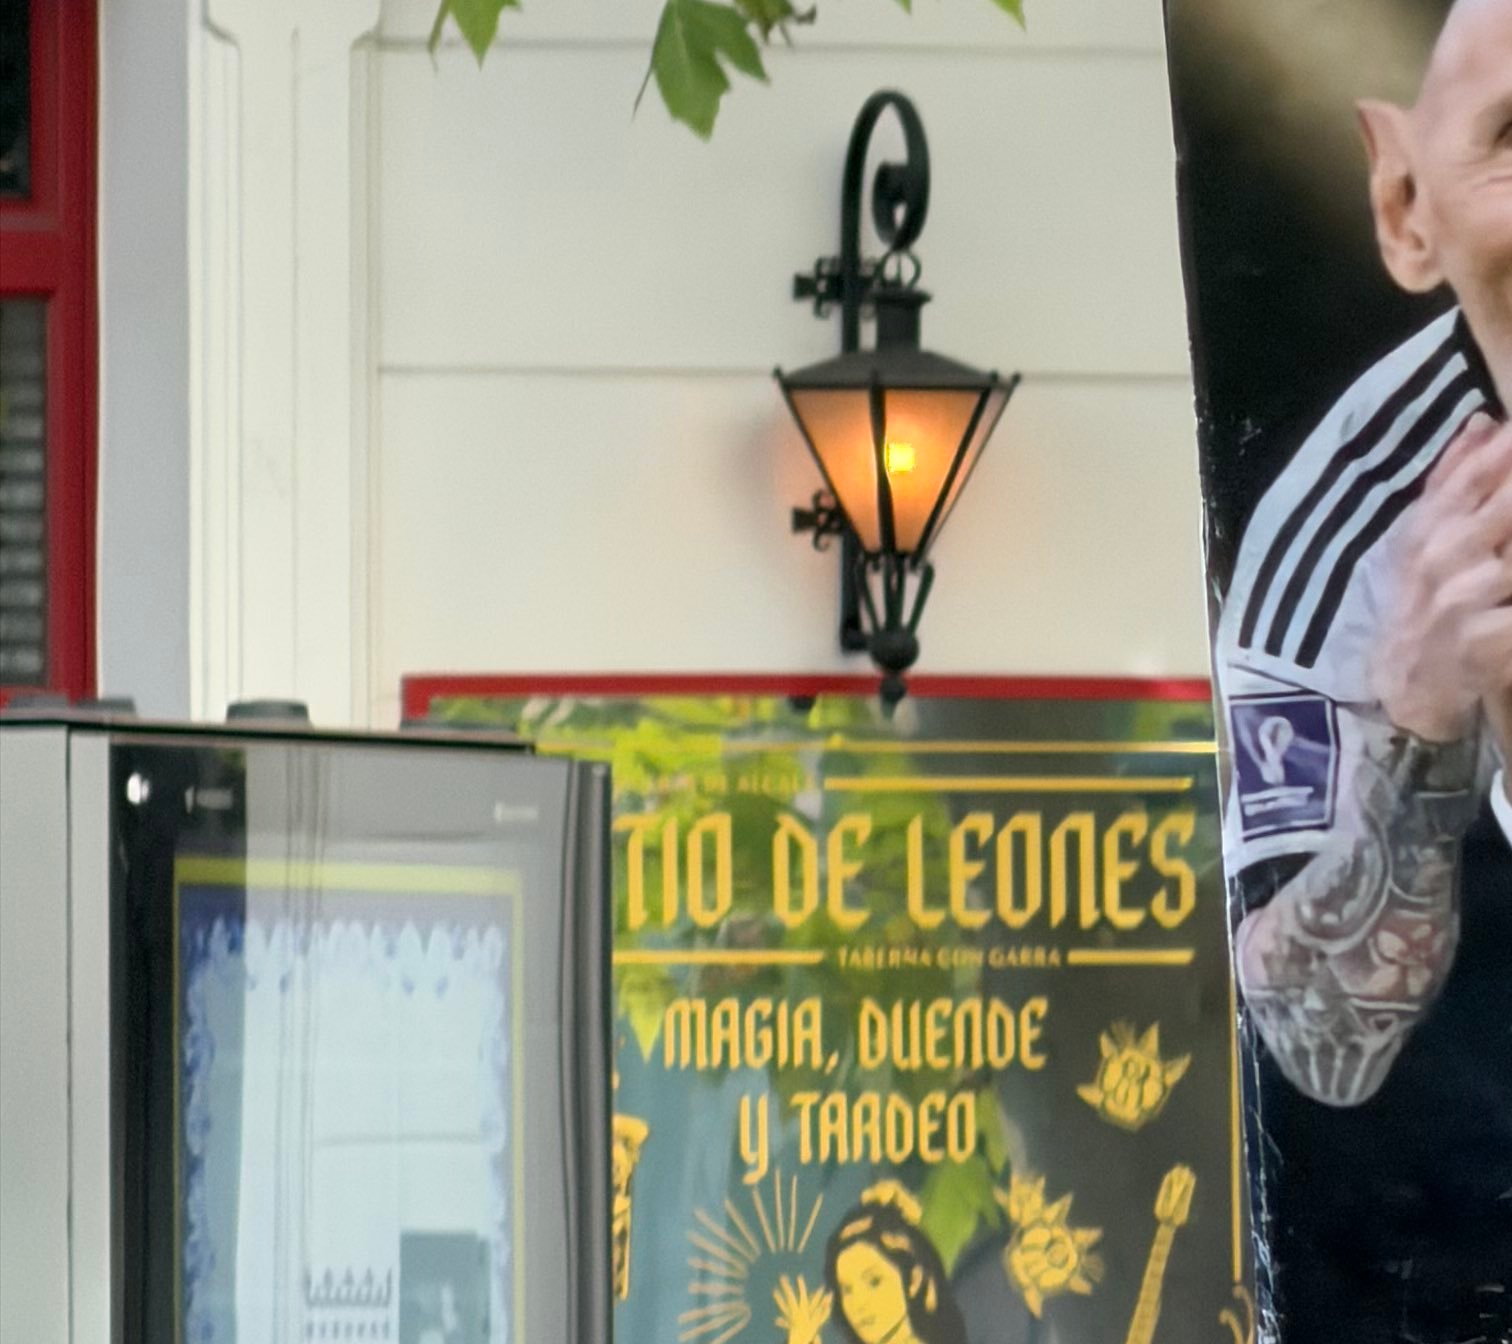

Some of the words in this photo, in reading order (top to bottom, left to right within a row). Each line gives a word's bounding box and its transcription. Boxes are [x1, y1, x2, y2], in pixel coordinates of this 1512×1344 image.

[611, 811, 733, 931] TIO
[772, 811, 873, 931] DE
[907, 810, 1197, 931] LEONES
[663, 997, 839, 1075] MAGIA,
[858, 997, 1049, 1071] DUENDE
[790, 1091, 977, 1165] TARDEO
